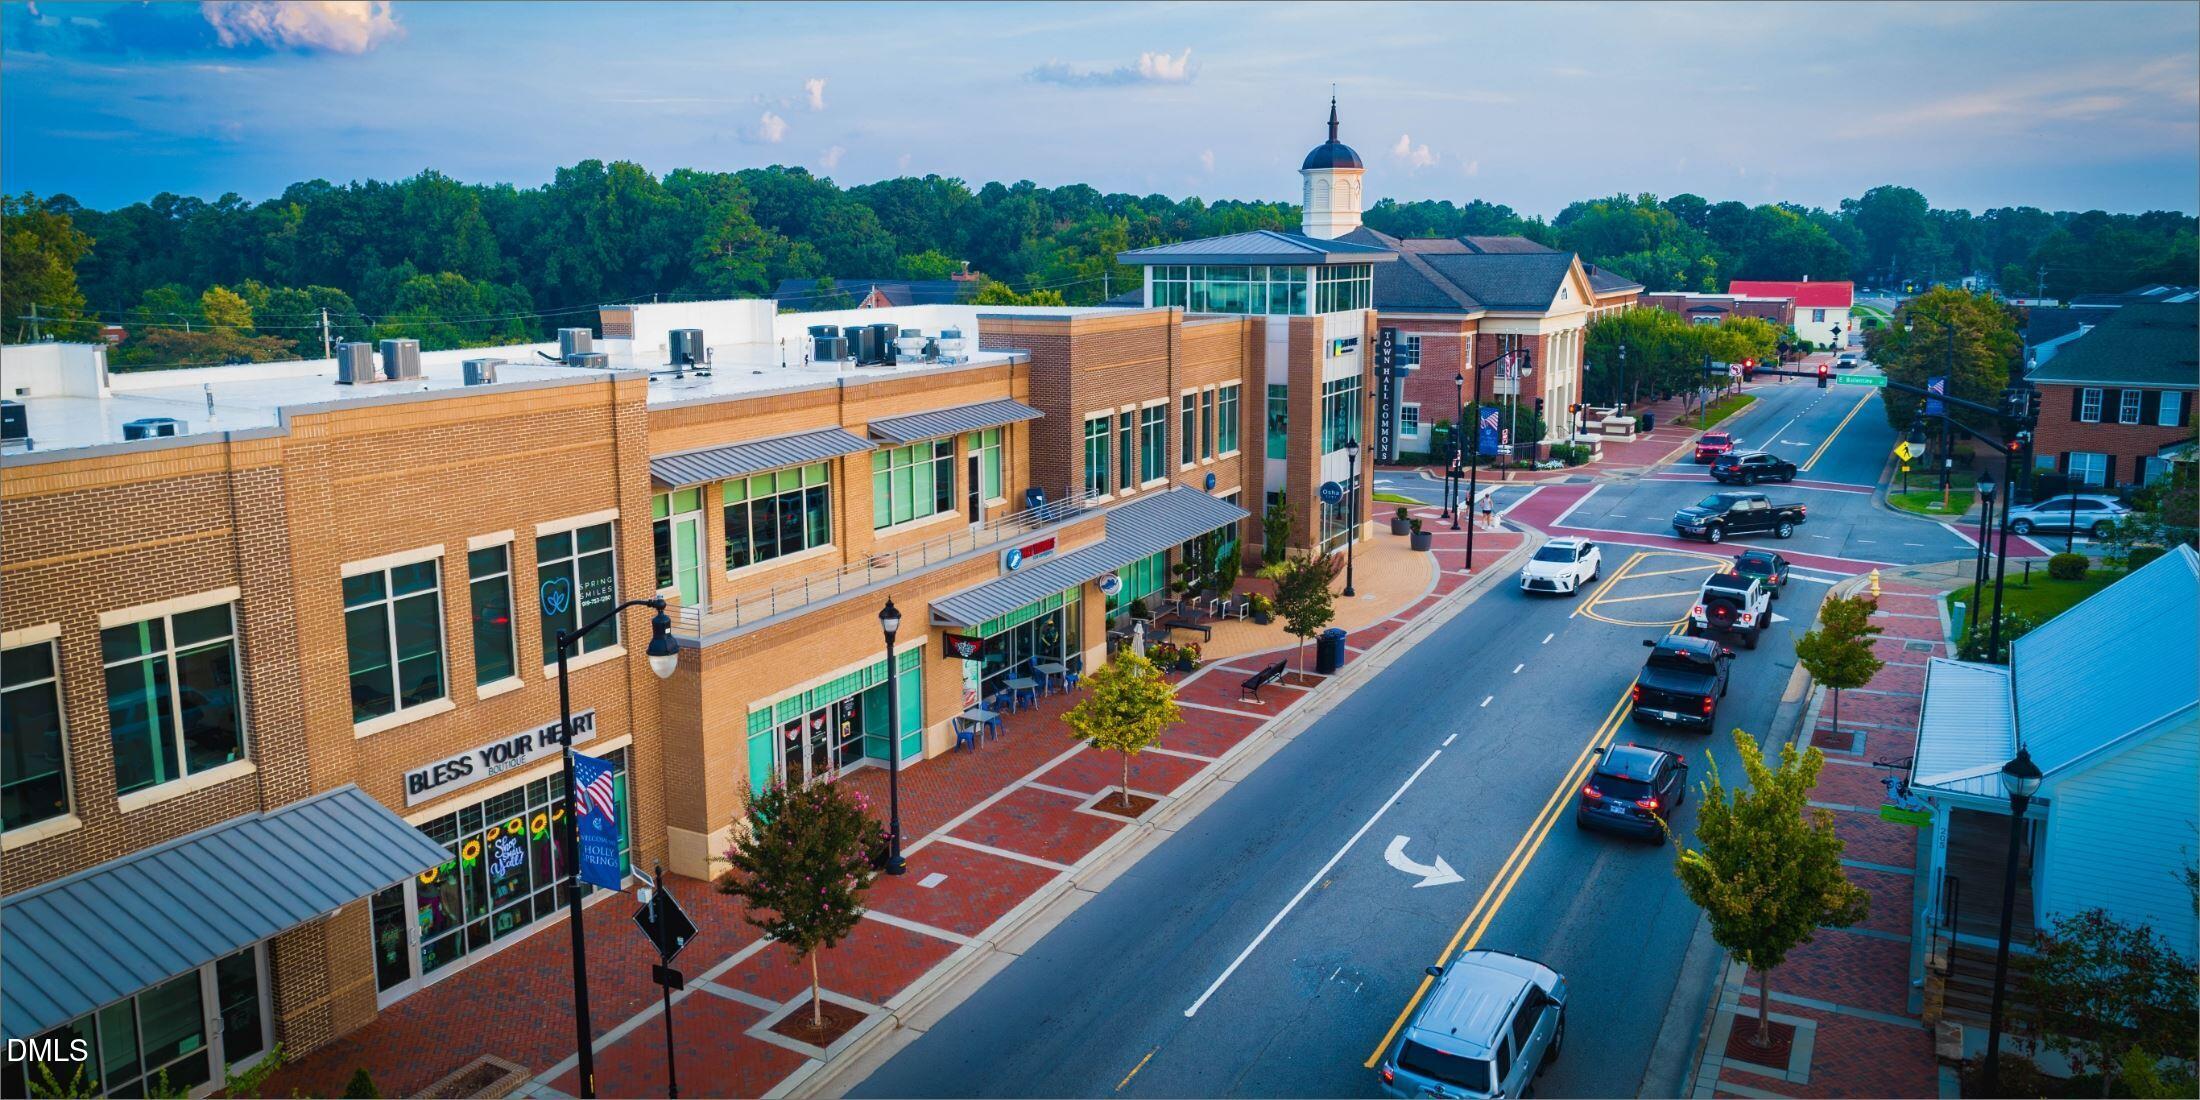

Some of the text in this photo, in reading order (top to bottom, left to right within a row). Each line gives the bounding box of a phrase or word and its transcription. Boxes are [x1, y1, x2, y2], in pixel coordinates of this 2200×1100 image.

[1383, 331, 1392, 364] TOWN
[1381, 404, 1390, 460] COMMONS
[579, 576, 613, 591] SPRING
[579, 585, 613, 600] SMILES
[409, 755, 474, 795] BLESS
[480, 734, 533, 768] YOUR
[488, 754, 527, 776] BOUTIQUE
[584, 845, 615, 857] HOLLY
[583, 854, 618, 868] PRINGS
